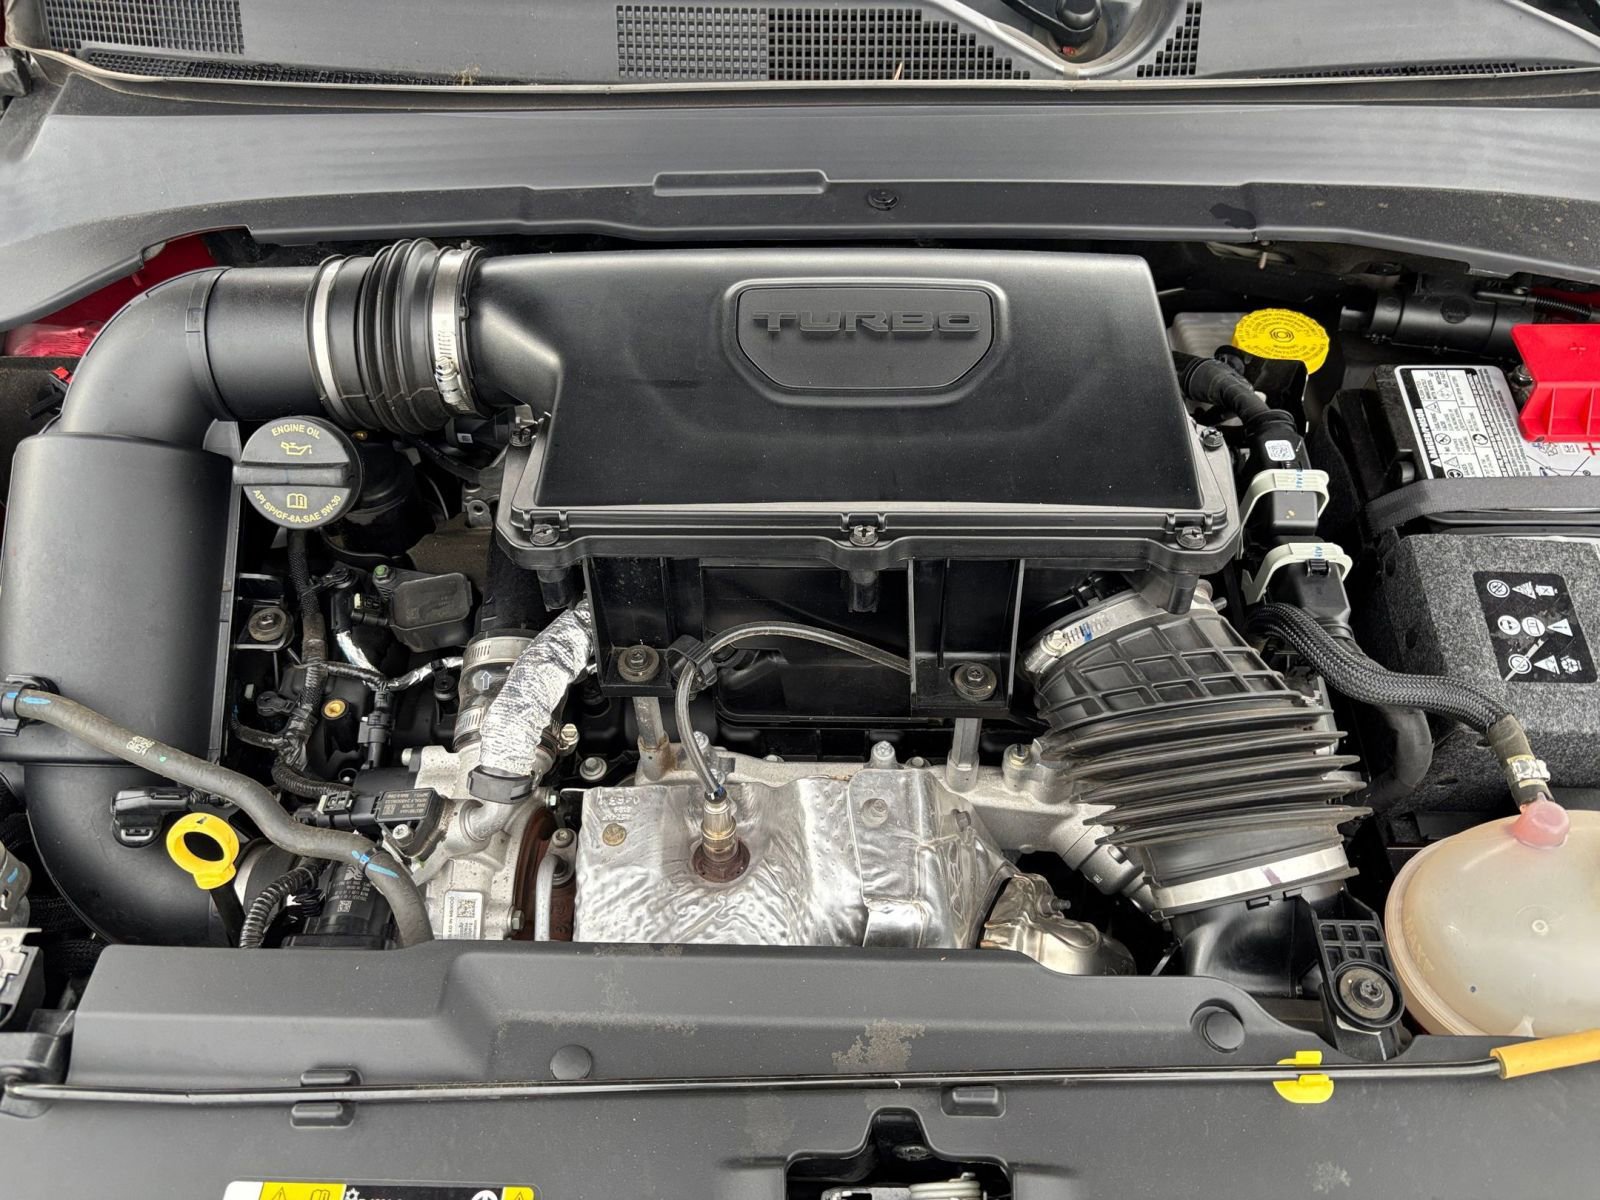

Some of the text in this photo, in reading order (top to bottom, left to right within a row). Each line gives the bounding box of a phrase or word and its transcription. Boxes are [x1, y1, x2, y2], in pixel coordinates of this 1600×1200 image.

[752, 311, 981, 333] TURBO
[271, 423, 321, 440] ENGINE OIL
[253, 489, 265, 505] API
[321, 494, 342, 517] 5W-30
